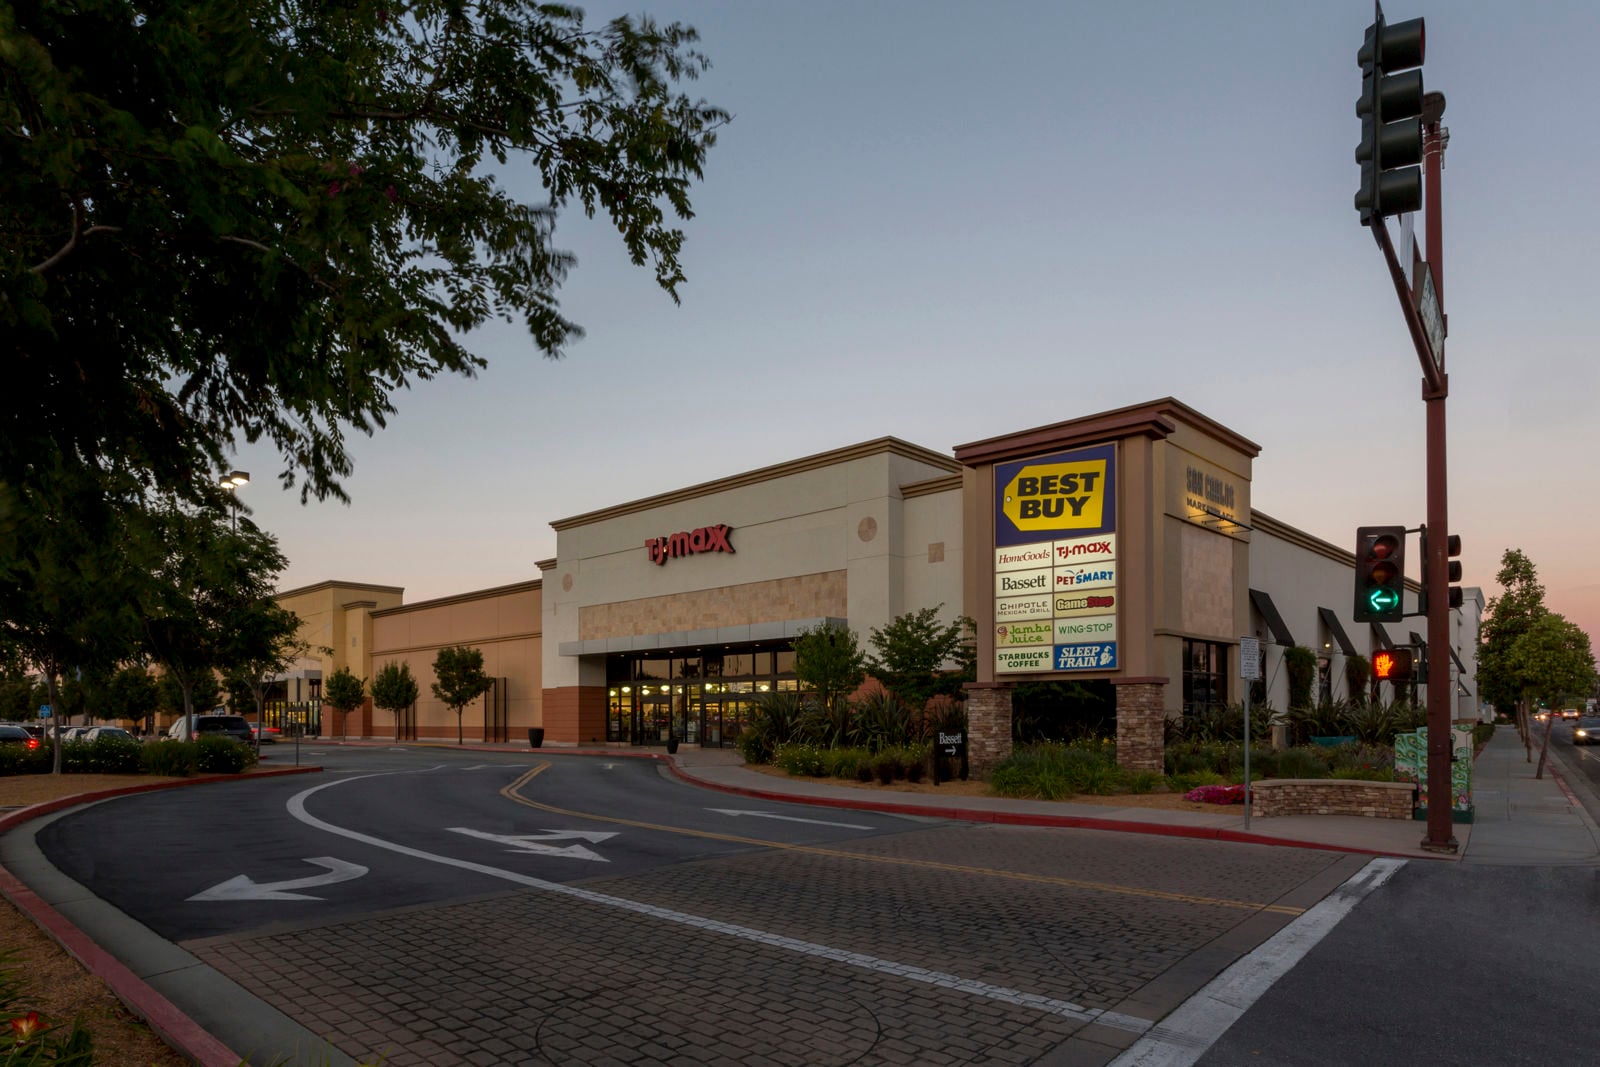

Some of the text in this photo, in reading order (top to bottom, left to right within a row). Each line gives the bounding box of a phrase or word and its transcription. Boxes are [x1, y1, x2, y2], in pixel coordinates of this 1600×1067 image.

[1018, 472, 1100, 496] BEST
[1020, 496, 1091, 519] BUY
[998, 549, 1051, 565] HomeGoods
[1001, 575, 1046, 591] Bassett
[1000, 601, 1048, 611] CHIPOTLE
[1009, 623, 1052, 635] Jamba
[1009, 634, 1044, 644] Juice
[998, 651, 1050, 661] STARBUCKS
[1061, 645, 1101, 658] SLEEP
[1007, 659, 1040, 668] COFFEE
[1058, 656, 1098, 668] TRAIN
[939, 732, 962, 744] Bassett
